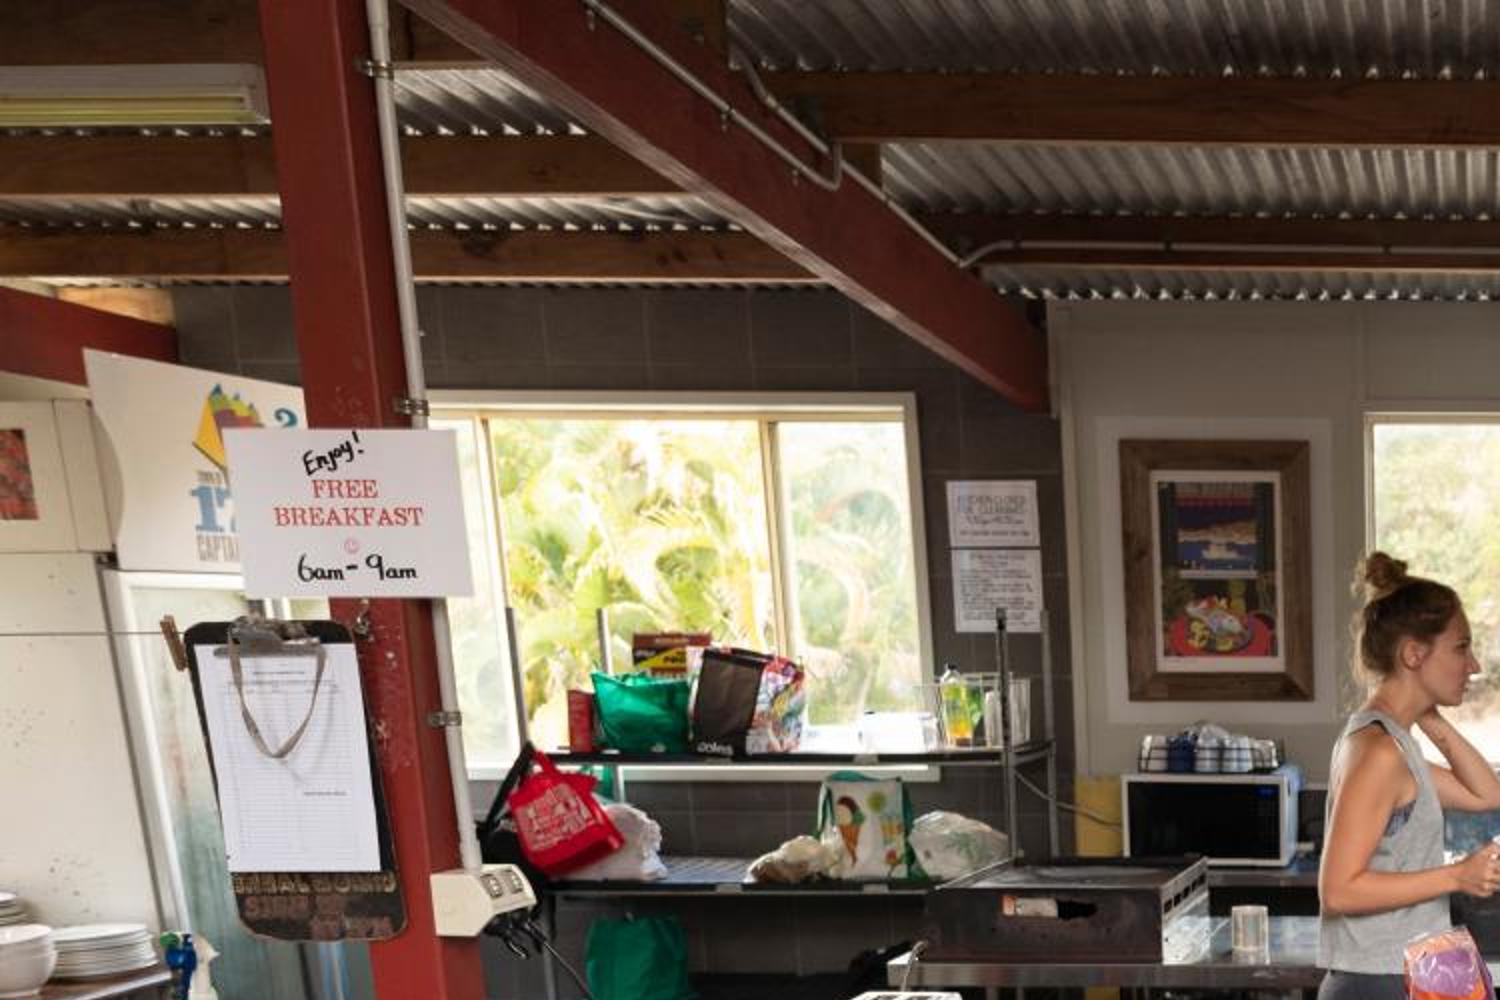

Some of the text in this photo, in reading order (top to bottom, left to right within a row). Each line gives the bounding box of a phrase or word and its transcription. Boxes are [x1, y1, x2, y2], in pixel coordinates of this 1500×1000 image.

[302, 430, 365, 475] Enjoy!
[312, 479, 379, 499] FREE
[273, 506, 424, 528] BREAKFAST
